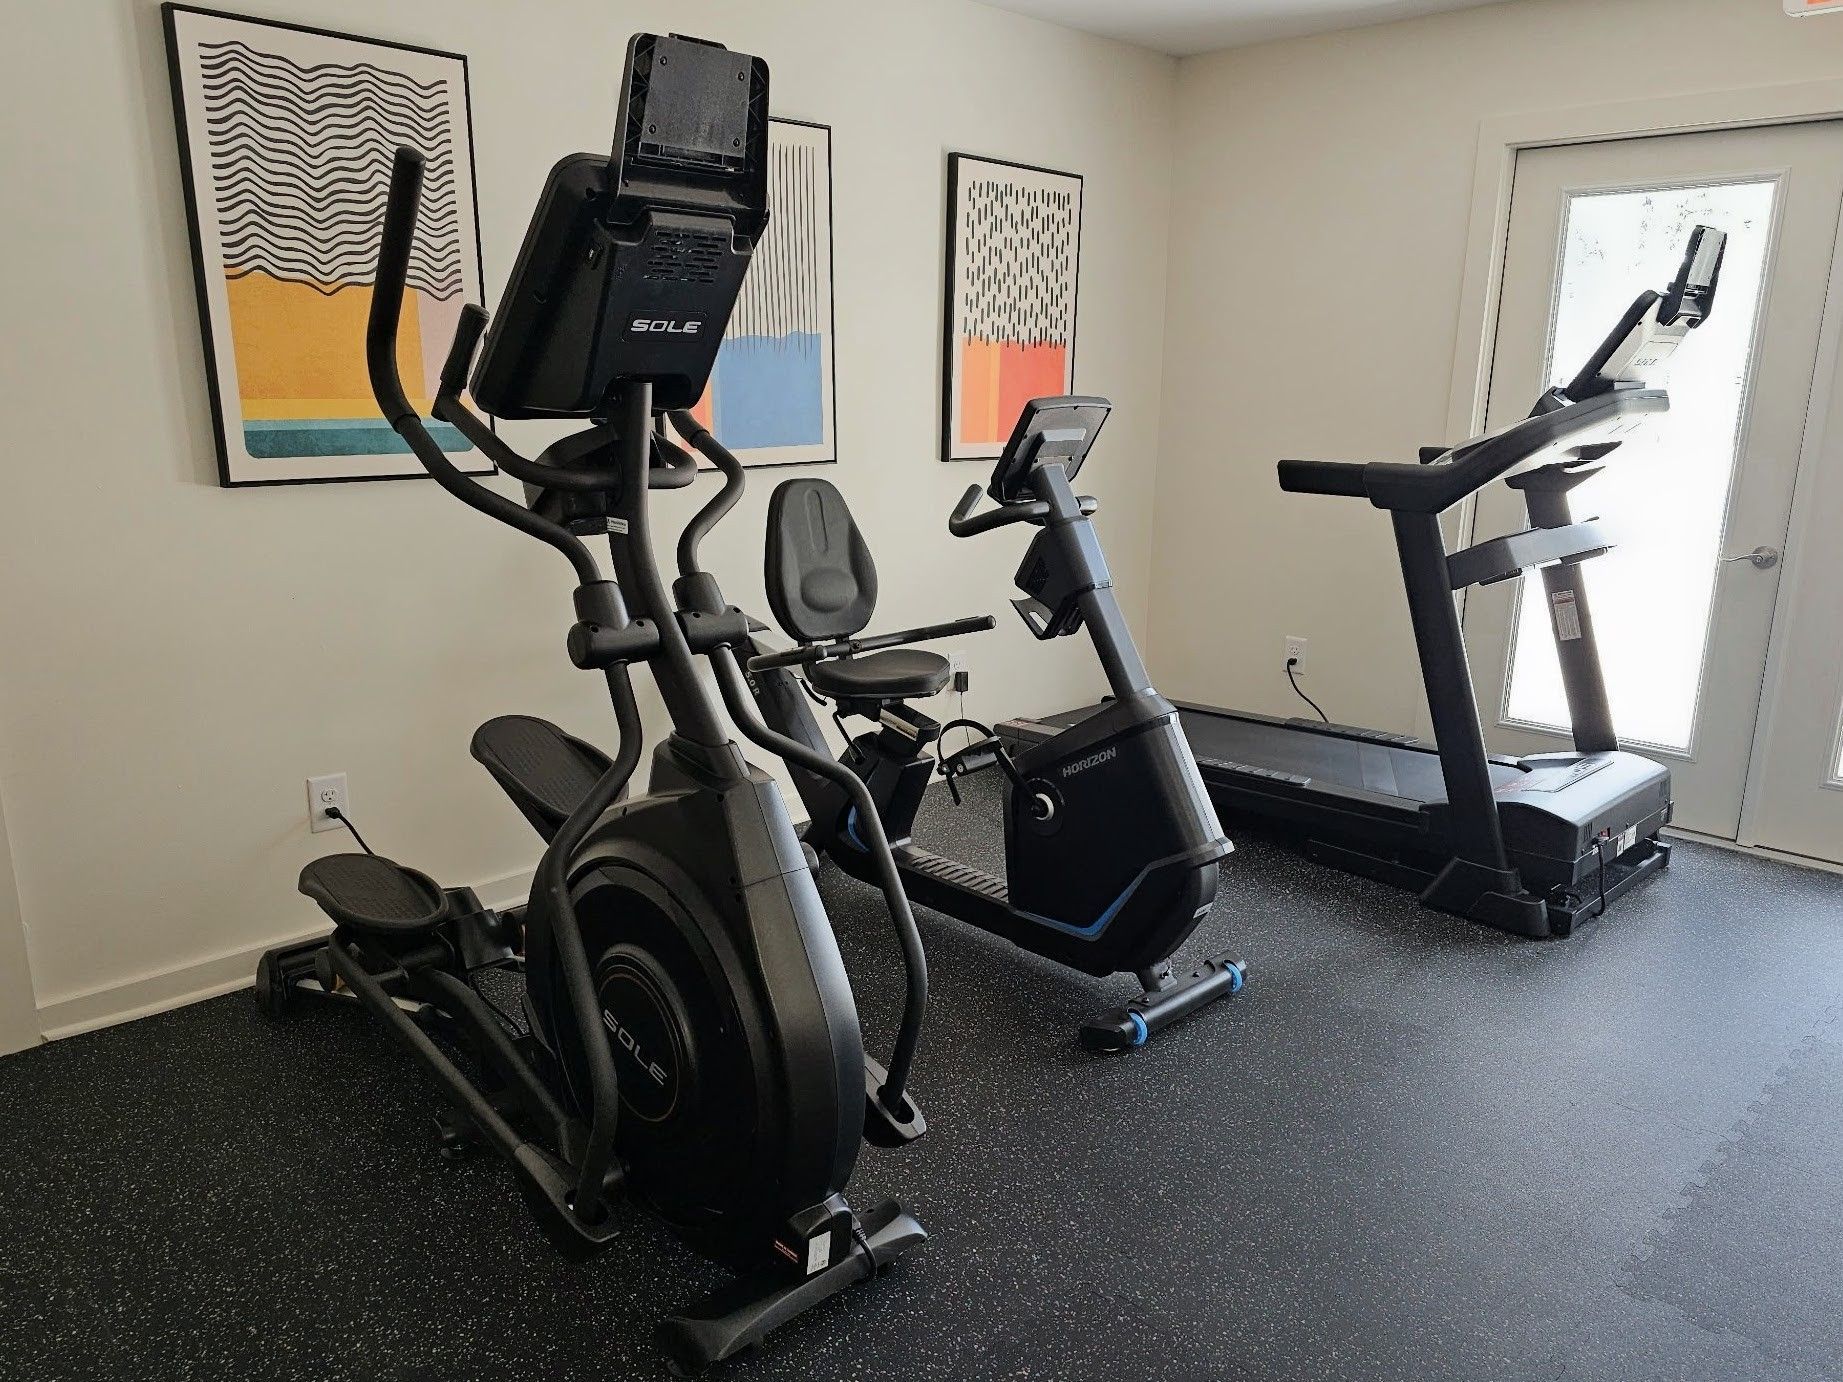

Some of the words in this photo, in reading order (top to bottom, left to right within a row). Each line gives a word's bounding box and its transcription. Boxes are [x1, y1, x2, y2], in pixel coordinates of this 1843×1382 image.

[630, 319, 702, 334] SOLE
[1062, 746, 1117, 778] HORIZON
[602, 1009, 668, 1086] SOLE
